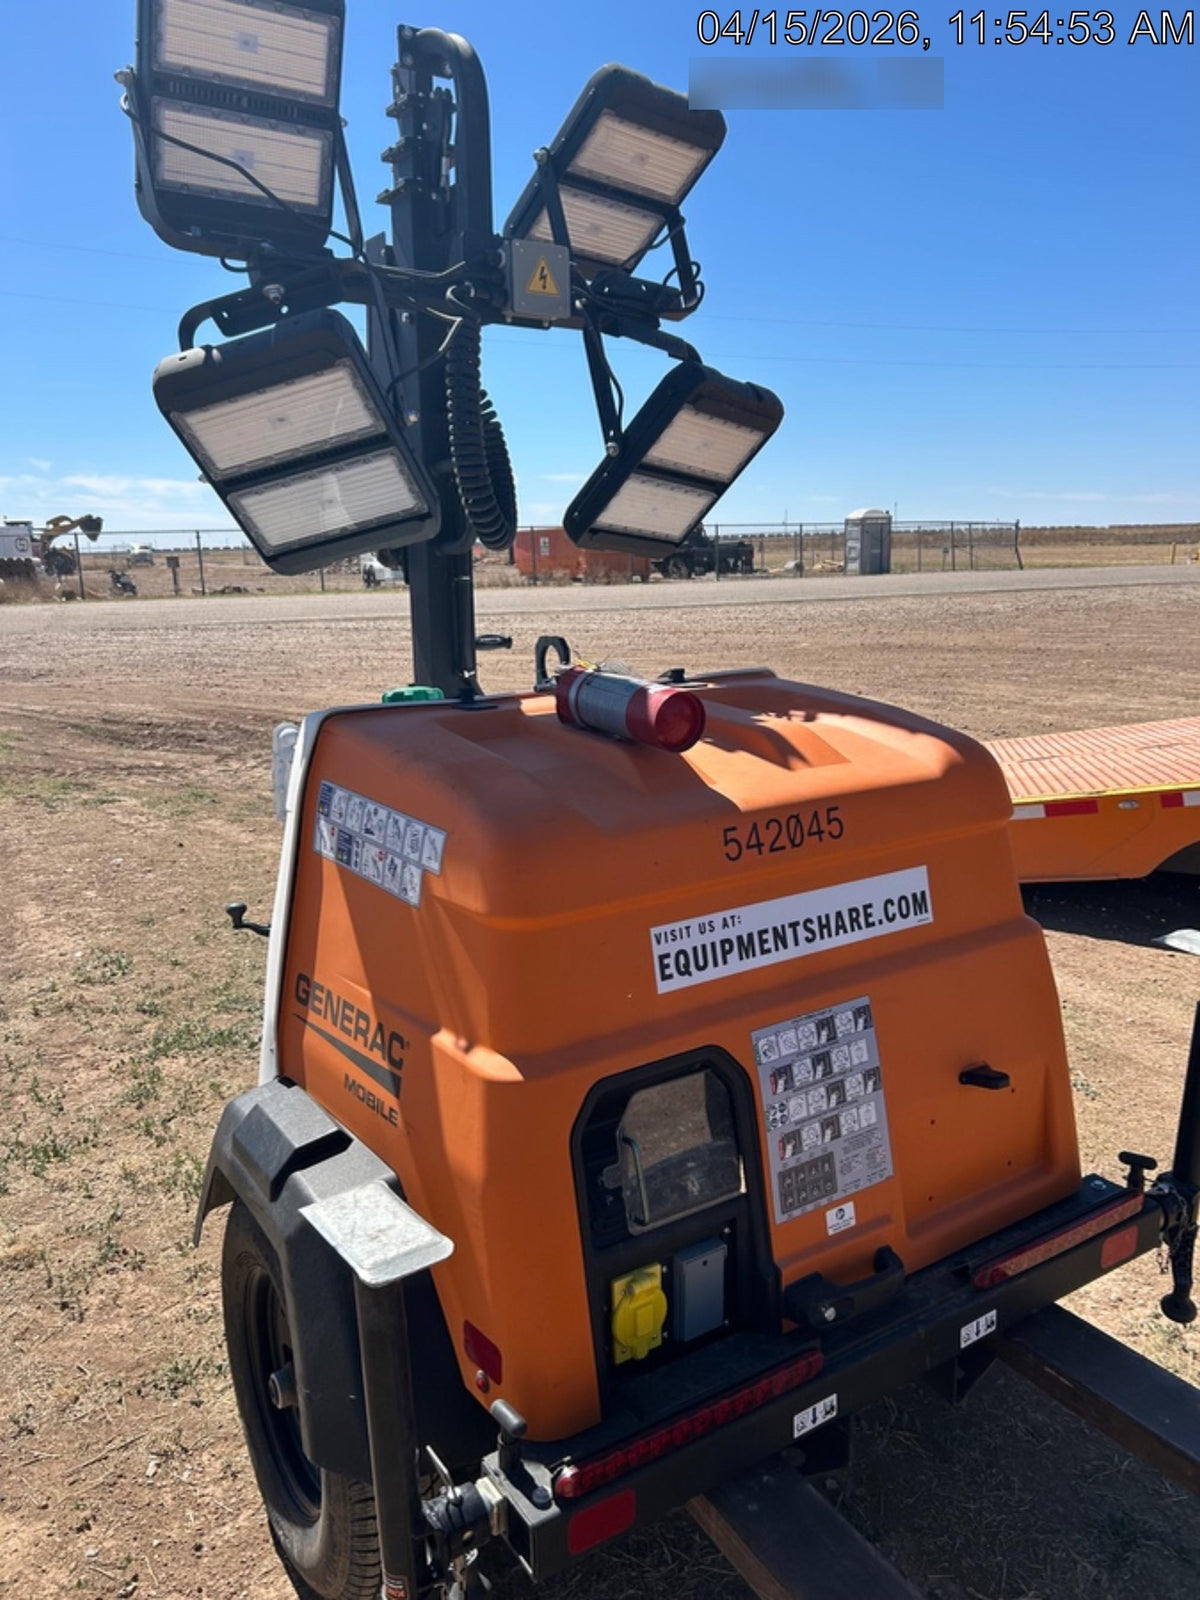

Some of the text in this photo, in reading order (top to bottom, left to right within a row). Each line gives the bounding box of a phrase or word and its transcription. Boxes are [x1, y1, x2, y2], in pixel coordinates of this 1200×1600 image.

[722, 805, 845, 862] 542045
[654, 914, 742, 946] VISIT US AT:
[657, 890, 930, 982] EQUIPMENTSHARE.COM
[294, 972, 406, 1071] GENERAC
[343, 1072, 399, 1128] MOBILE
